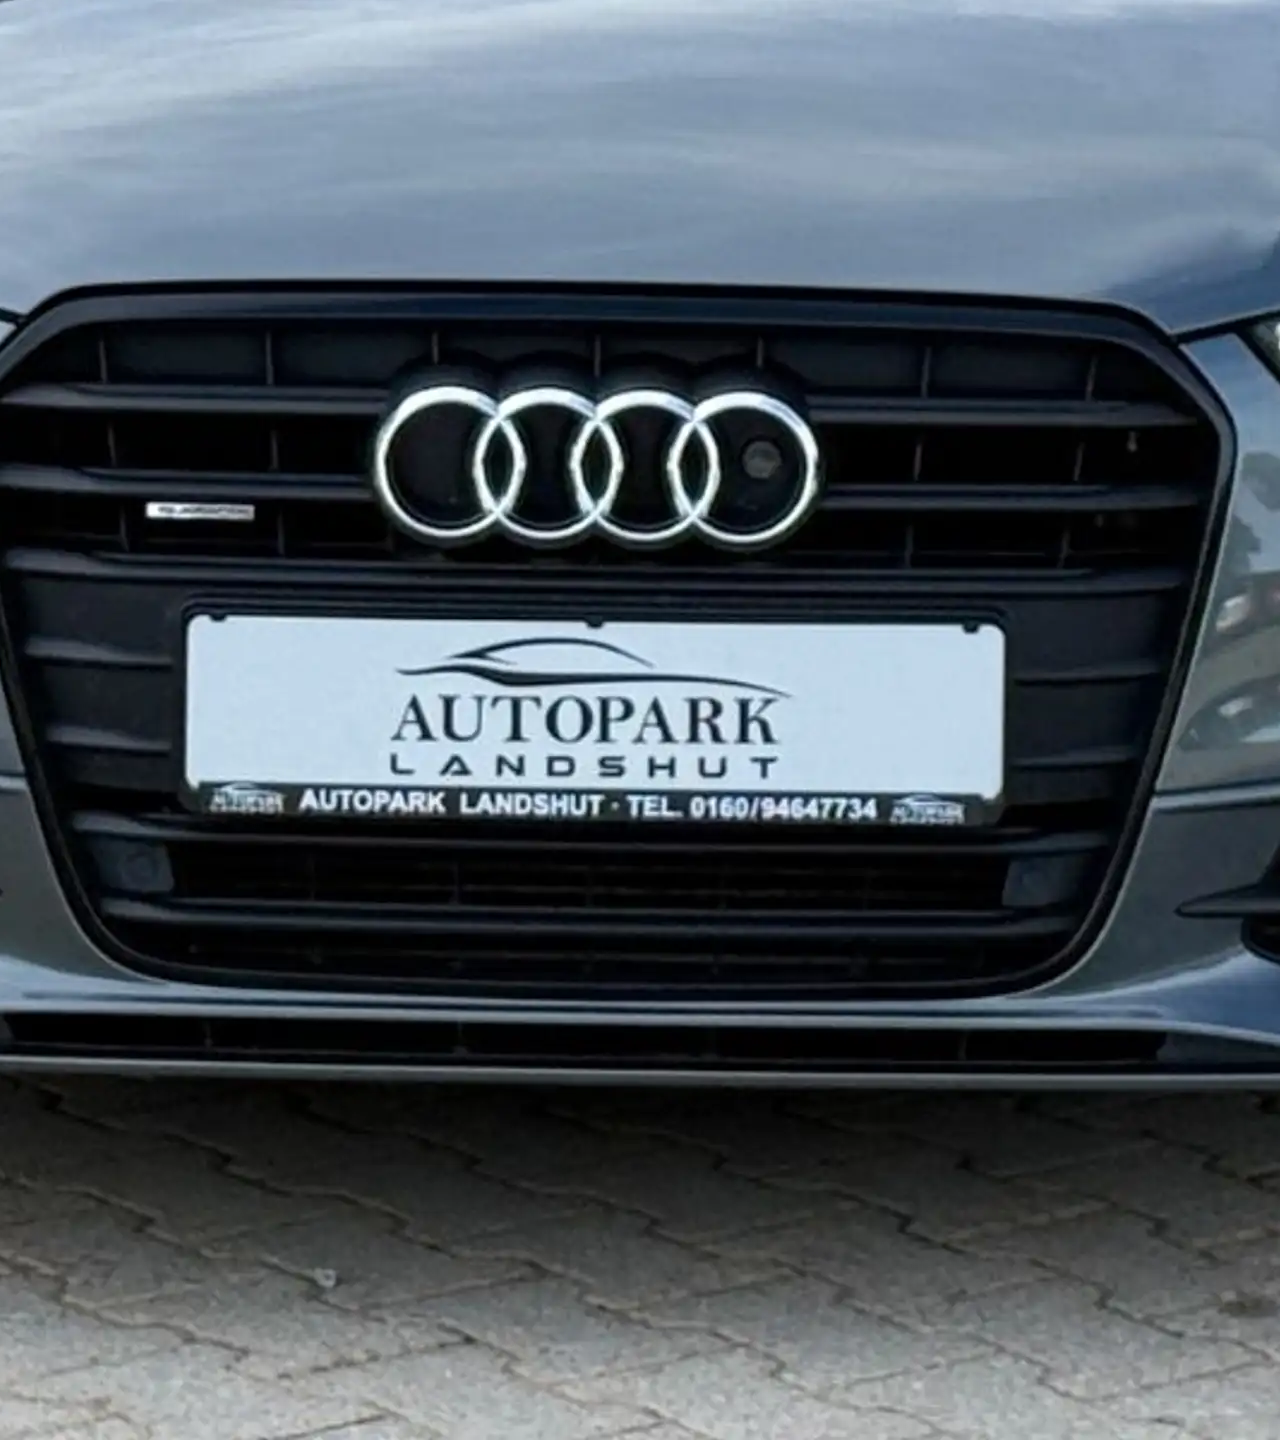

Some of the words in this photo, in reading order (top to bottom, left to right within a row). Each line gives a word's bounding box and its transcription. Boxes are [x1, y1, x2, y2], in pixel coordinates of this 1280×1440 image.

[390, 693, 779, 745] AUTOPARK
[390, 753, 778, 778] LANDSHUT
[299, 788, 446, 814] AUTOPARK
[458, 791, 606, 817] LANDSHUT
[689, 796, 878, 821] 0160/94647734
